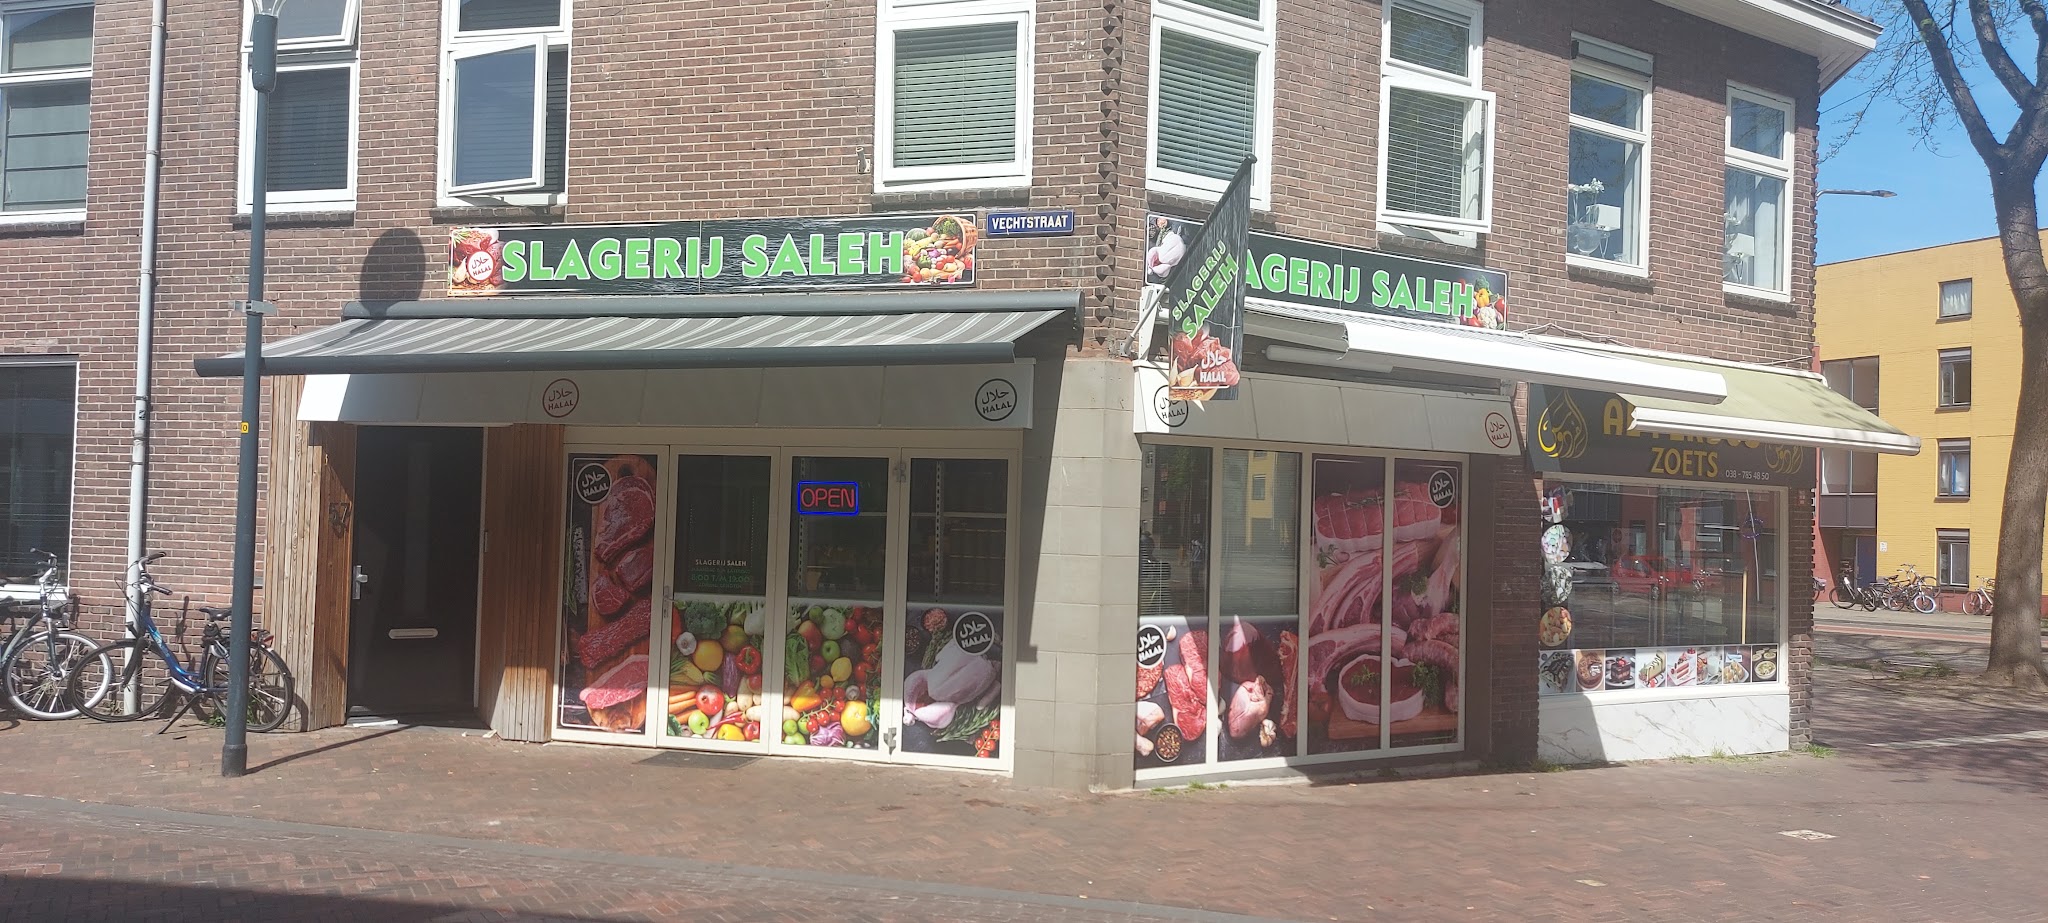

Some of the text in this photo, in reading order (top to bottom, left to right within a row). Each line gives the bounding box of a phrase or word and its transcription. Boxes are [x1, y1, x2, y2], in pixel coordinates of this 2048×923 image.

[992, 215, 1068, 229] VECHTSTRAAT
[471, 256, 489, 270] حلال
[502, 231, 904, 282] SLAGERIJ SALEH
[472, 265, 492, 277] HALAL
[1172, 240, 1226, 321] SLAGERIJ
[1245, 249, 1474, 318] AGERIJ SALEH
[1182, 253, 1239, 340] SALEH
[1201, 350, 1227, 369] حلال
[1200, 371, 1226, 383] HALAL
[548, 388, 572, 402] حلال
[981, 389, 1009, 405] حلال
[548, 400, 574, 411] HALAL
[982, 401, 1012, 414] HALAL
[1161, 408, 1185, 419] HALAL
[1490, 421, 1505, 433] حلال
[1491, 433, 1509, 441] HALAL
[1651, 447, 1719, 478] ZOETS
[581, 471, 606, 488] حلال
[1432, 478, 1450, 494] حلال
[582, 482, 609, 498] HALAL
[801, 488, 855, 508] OPEN
[1433, 489, 1453, 502] HALAL
[960, 620, 987, 639] حلال
[961, 633, 991, 648] HALAL
[1138, 645, 1164, 662] HALAL
